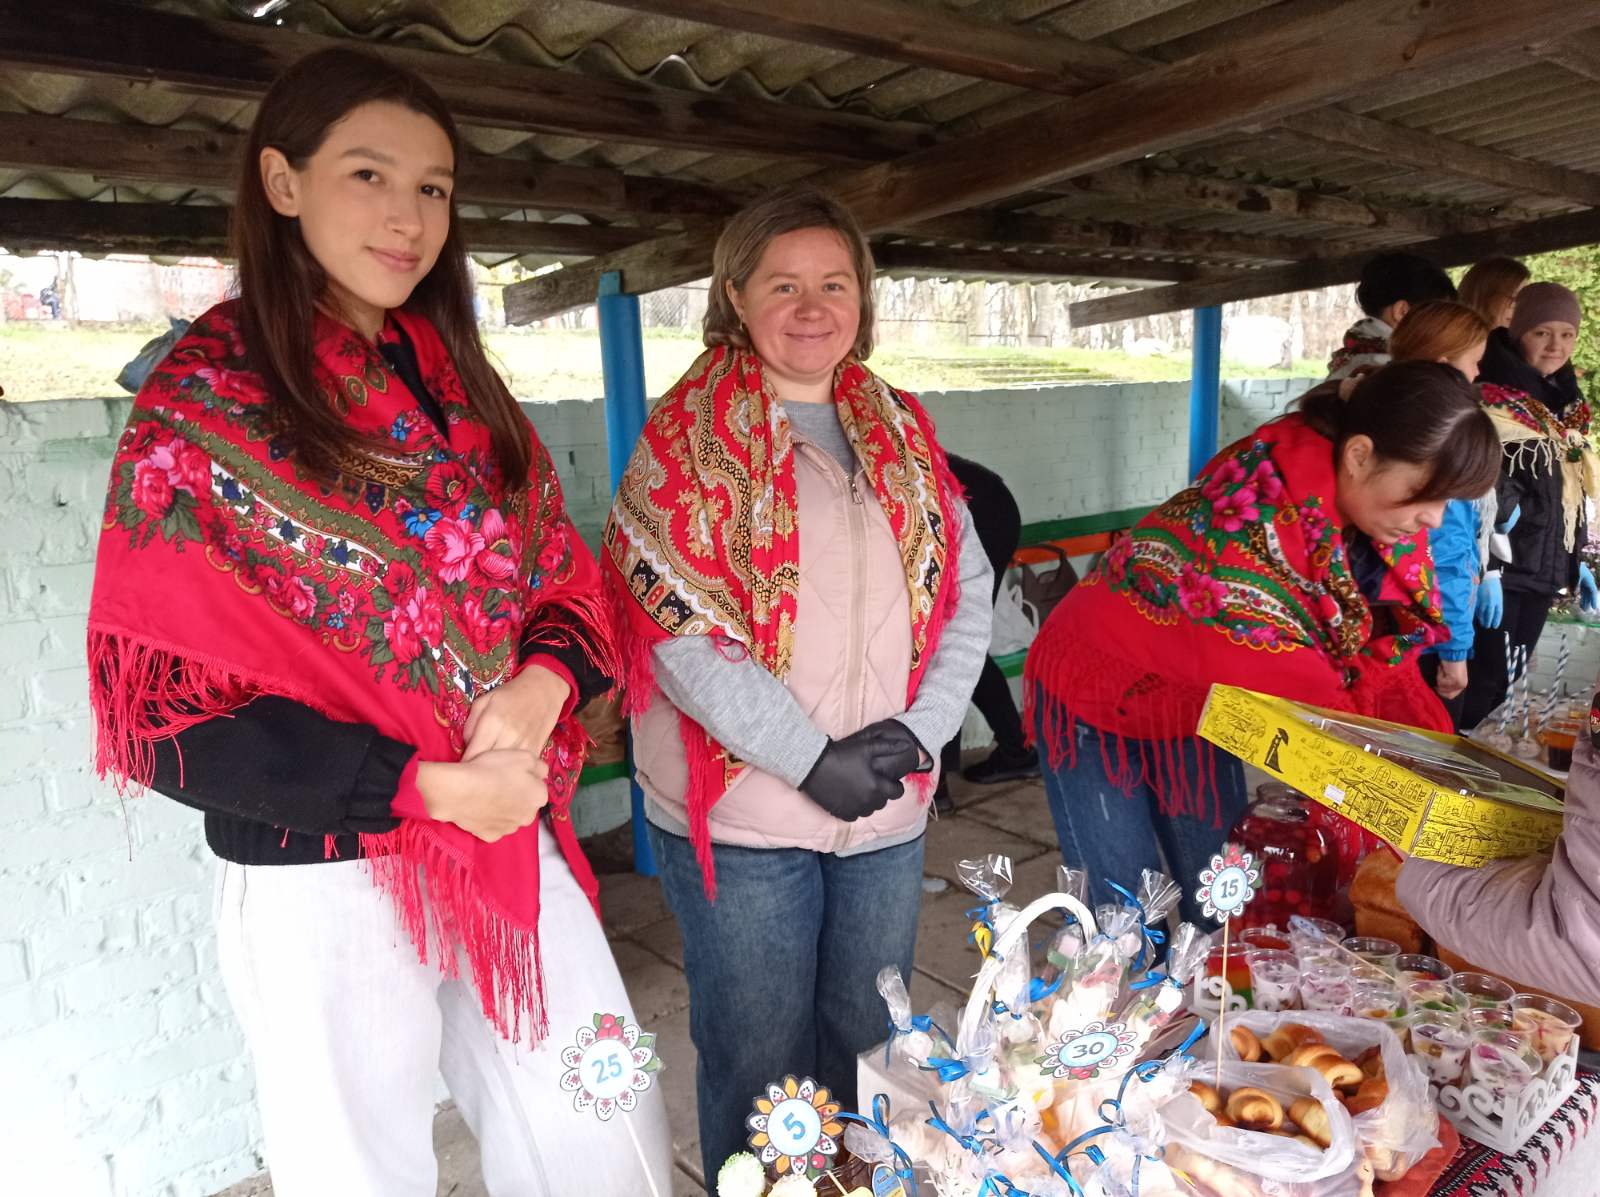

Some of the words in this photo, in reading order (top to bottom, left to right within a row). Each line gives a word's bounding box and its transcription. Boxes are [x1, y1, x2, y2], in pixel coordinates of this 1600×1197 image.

[1220, 879, 1239, 899] 15
[1072, 1041, 1105, 1059] 30
[591, 1052, 622, 1084] 25
[782, 1111, 806, 1140] 5
